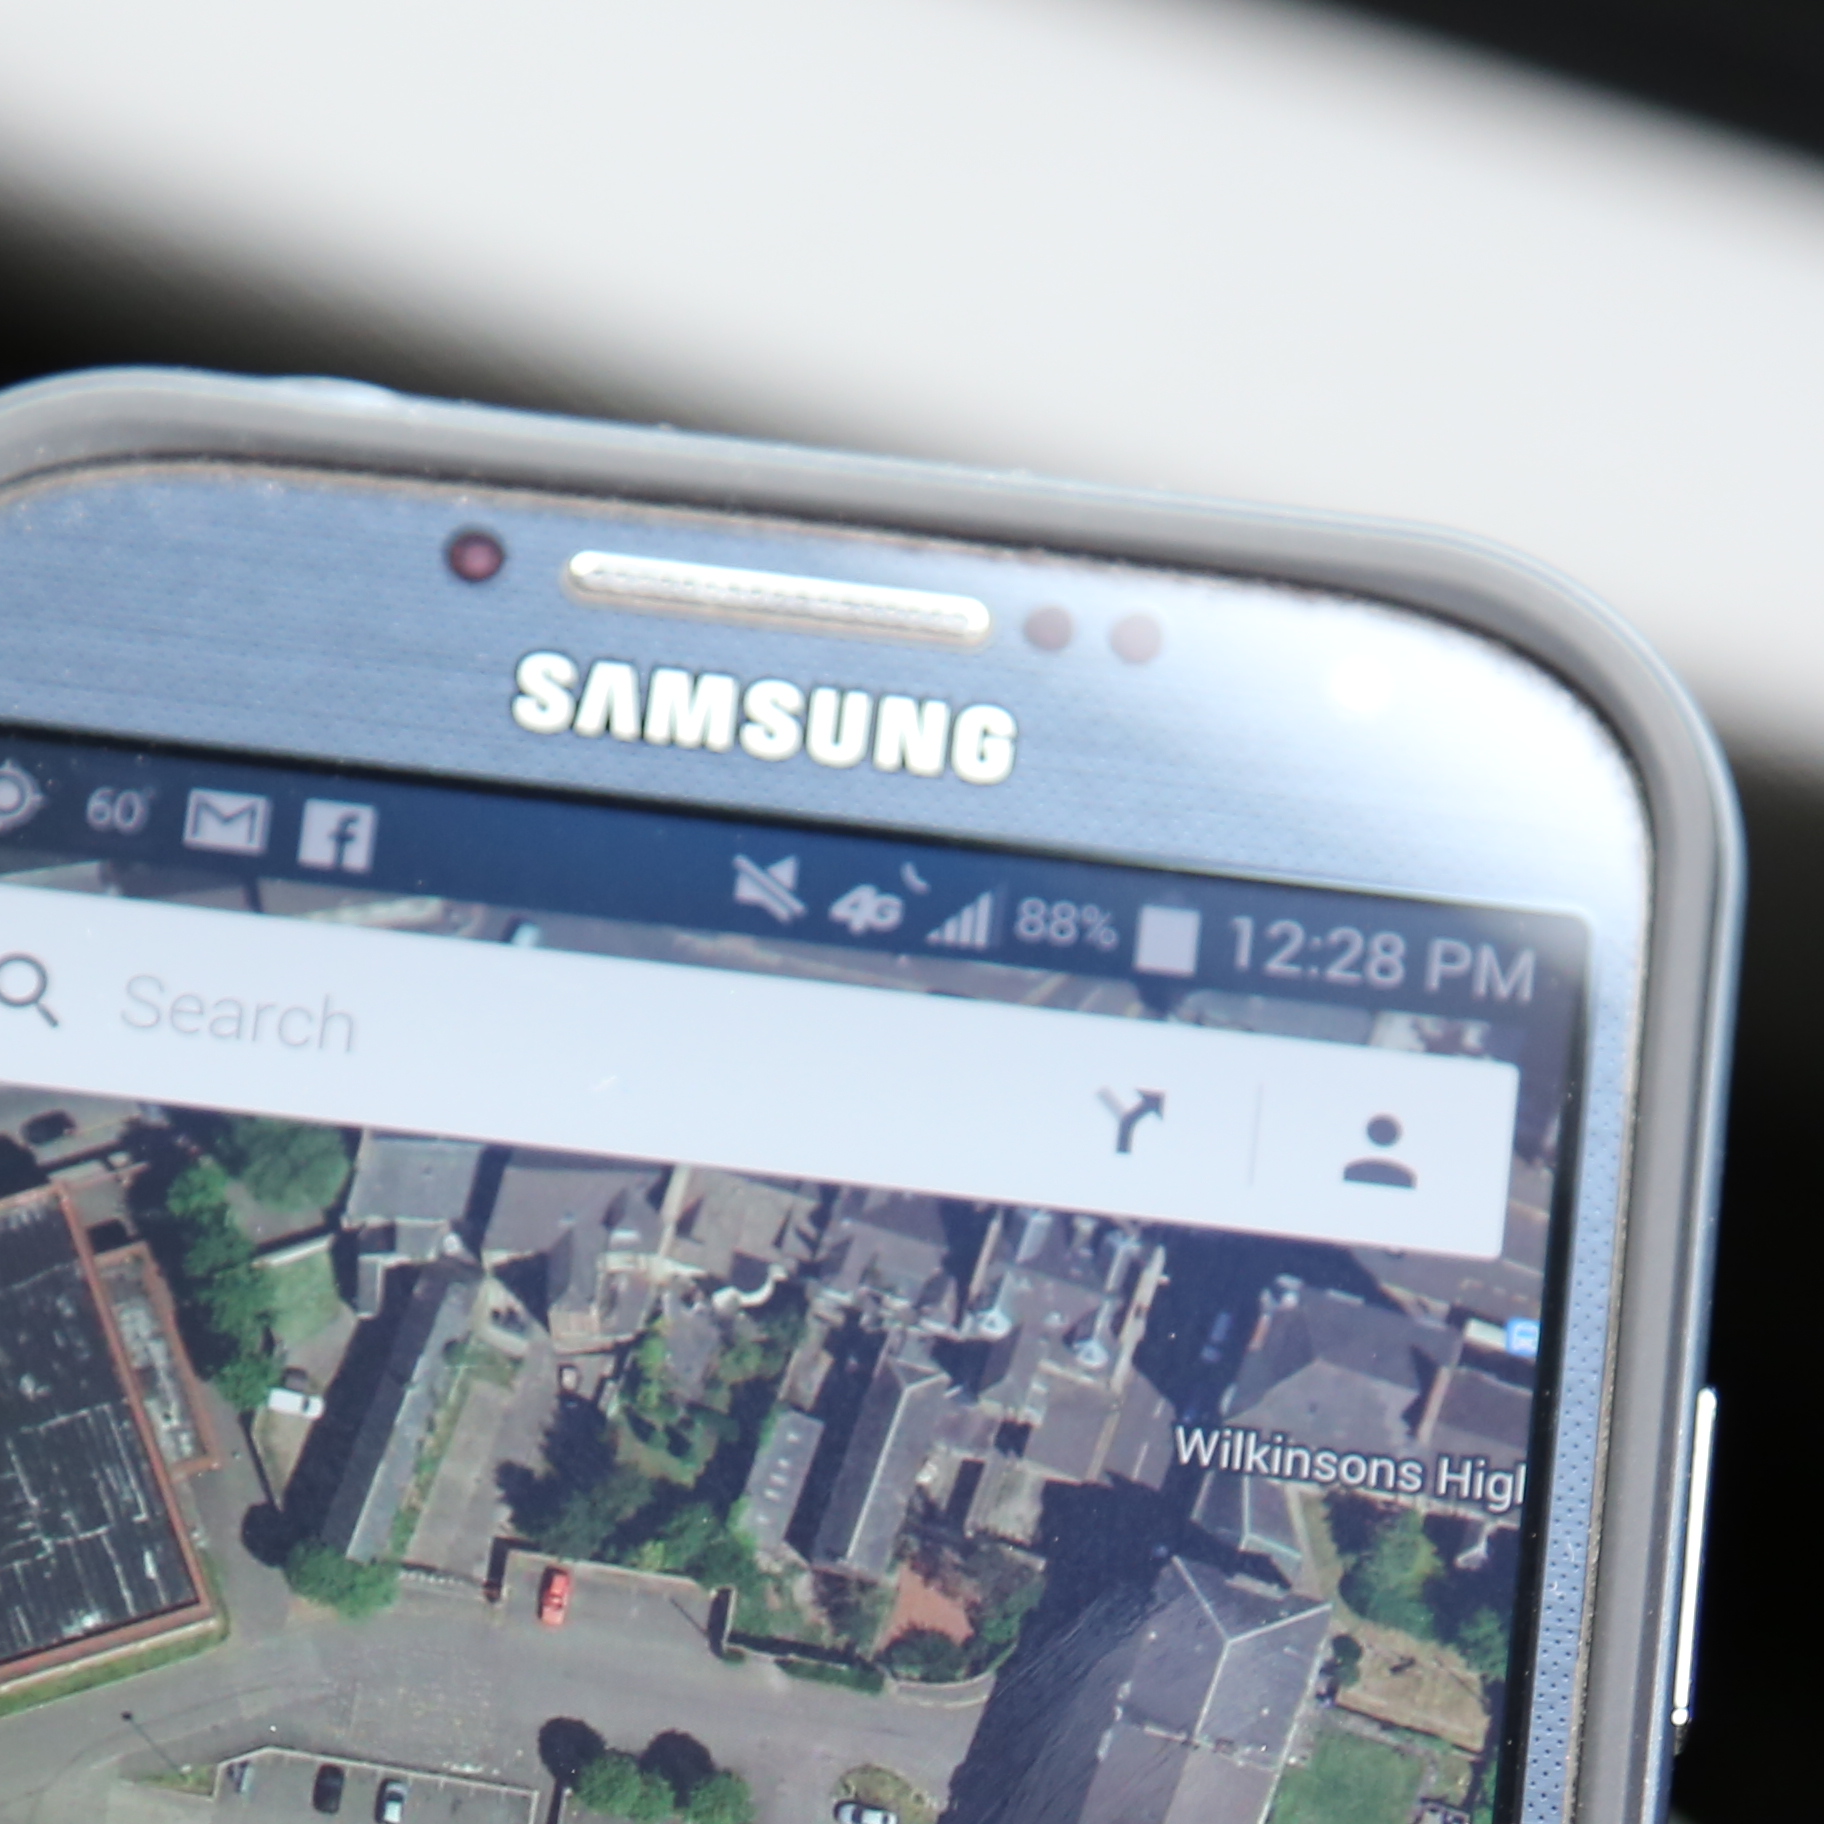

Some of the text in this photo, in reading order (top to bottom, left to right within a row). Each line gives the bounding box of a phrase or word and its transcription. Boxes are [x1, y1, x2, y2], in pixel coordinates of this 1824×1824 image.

[512, 650, 1018, 785] SAMSUNG
[829, 884, 904, 934] 4G
[1015, 897, 1536, 1004] 88% 12:28 PM
[120, 973, 355, 1054] Search
[1175, 1424, 1423, 1493] Wilkinsons
